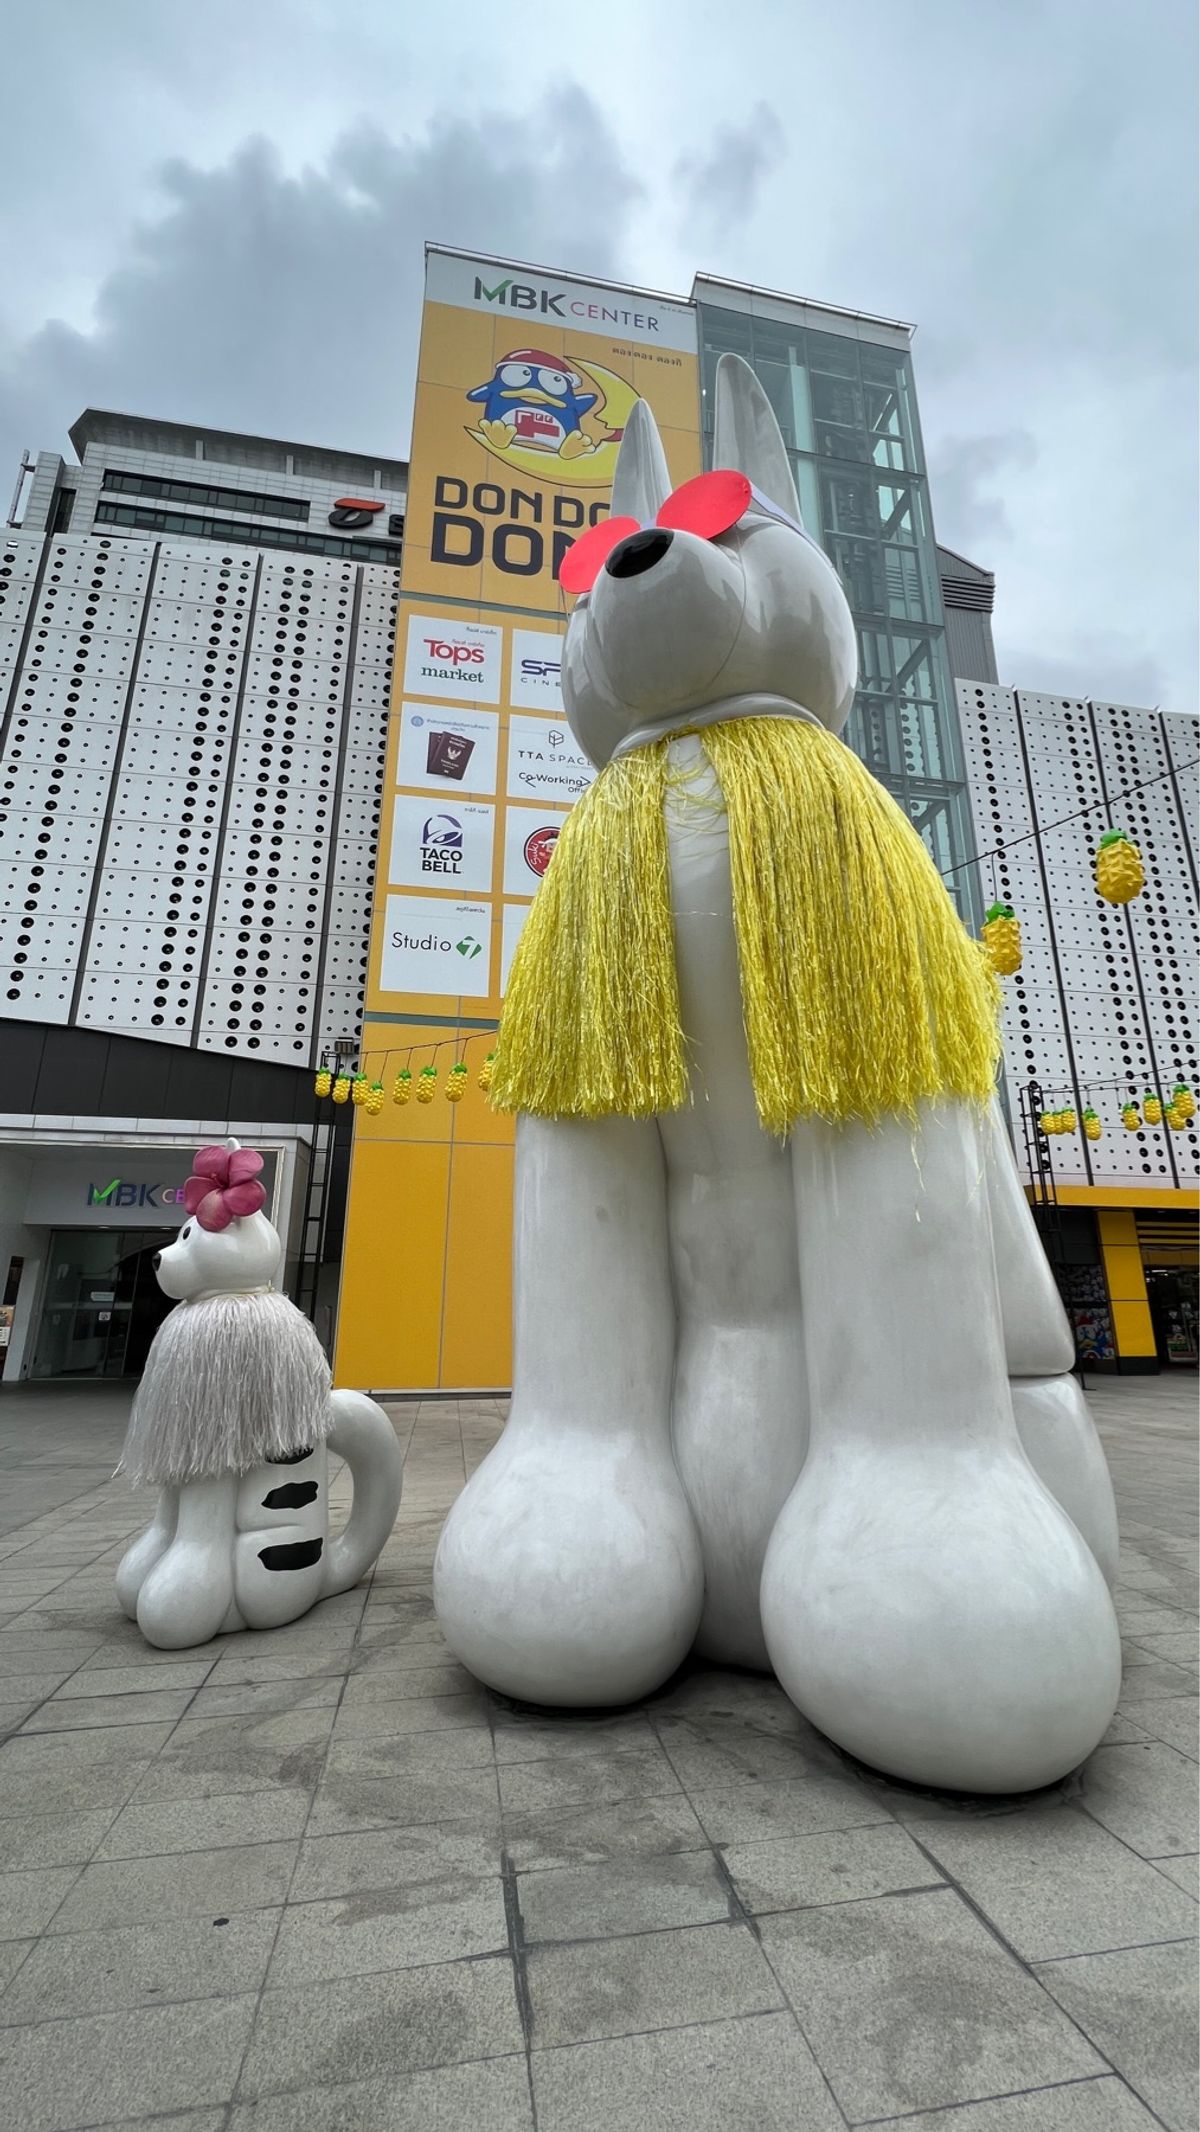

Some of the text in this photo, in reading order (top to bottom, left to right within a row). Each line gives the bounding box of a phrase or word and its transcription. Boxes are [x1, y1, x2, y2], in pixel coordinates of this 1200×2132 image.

[474, 276, 660, 331] MBK CENTER
[434, 476, 542, 523] DON
[423, 639, 485, 666] Tops
[421, 667, 485, 683] market
[518, 750, 544, 761] TTA
[420, 847, 463, 862] TACO
[422, 860, 462, 874] BELL
[392, 932, 480, 959] Studio 7
[87, 1179, 161, 1207] MBK
